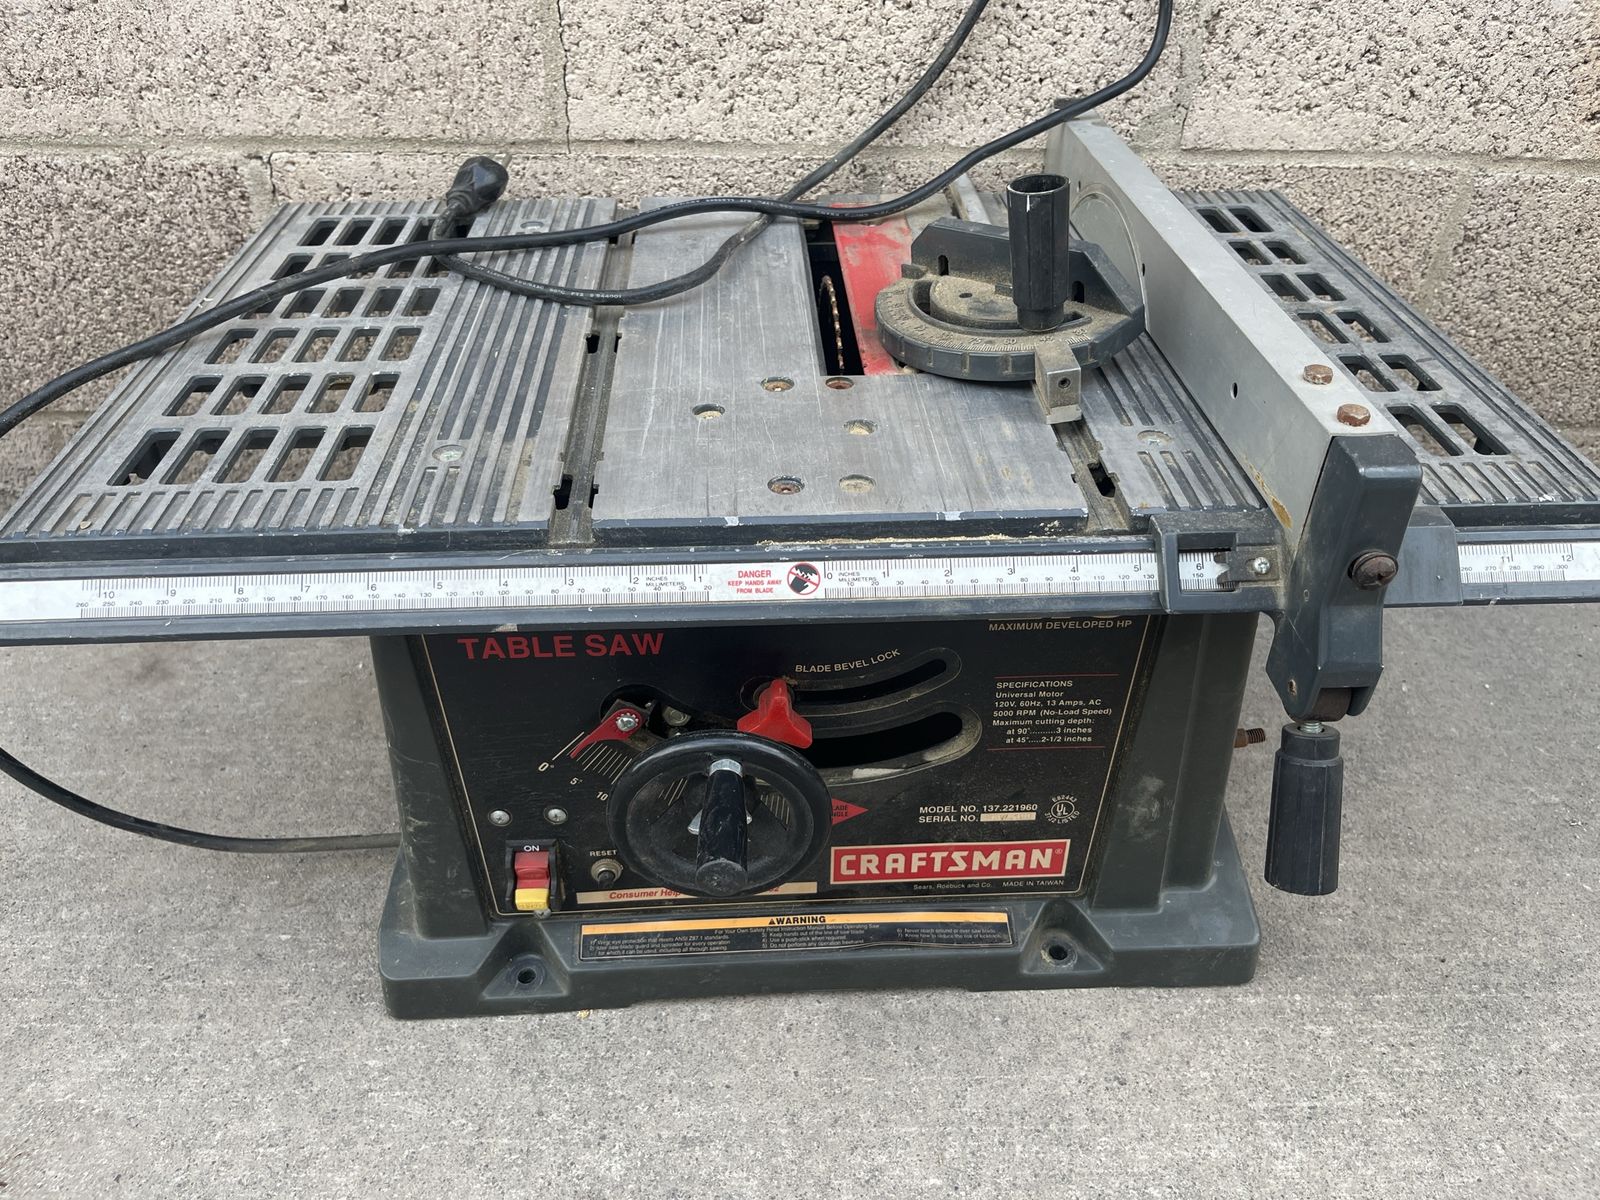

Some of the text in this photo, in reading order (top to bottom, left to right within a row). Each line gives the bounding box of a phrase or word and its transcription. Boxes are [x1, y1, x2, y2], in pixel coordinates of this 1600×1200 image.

[737, 570, 772, 579] DANGER
[827, 572, 833, 580] 0
[882, 570, 886, 578] 1
[944, 569, 950, 577] 2
[1196, 563, 1202, 571] 6
[103, 591, 115, 599] 10
[170, 589, 177, 597] 9
[238, 587, 244, 595] 8
[304, 585, 310, 593] 7
[370, 584, 377, 592] 6
[437, 581, 443, 589] 5
[502, 580, 508, 588] 4
[633, 576, 640, 584] 2
[698, 575, 702, 583] 1
[988, 620, 1133, 631] MAXIMUM DEVELOPED HP
[457, 632, 665, 660] TABLE SAW
[794, 648, 901, 673] BLADE BEVEL LOCK
[996, 680, 1073, 689] SPECIFICATIONS
[995, 691, 1036, 699] Universal
[1040, 708, 1080, 717] (No-Load
[1081, 708, 1112, 716] Speed)
[1035, 718, 1065, 726] cutting
[1067, 717, 1095, 725] depth:
[919, 803, 1038, 814] MODEL NO. 137.221960
[918, 814, 957, 823] SERIAL
[960, 814, 979, 822] NO.
[1056, 810, 1080, 824] LISTED
[589, 849, 617, 857] RESET
[609, 890, 659, 900] Consumer
[776, 916, 826, 925] WARNING
